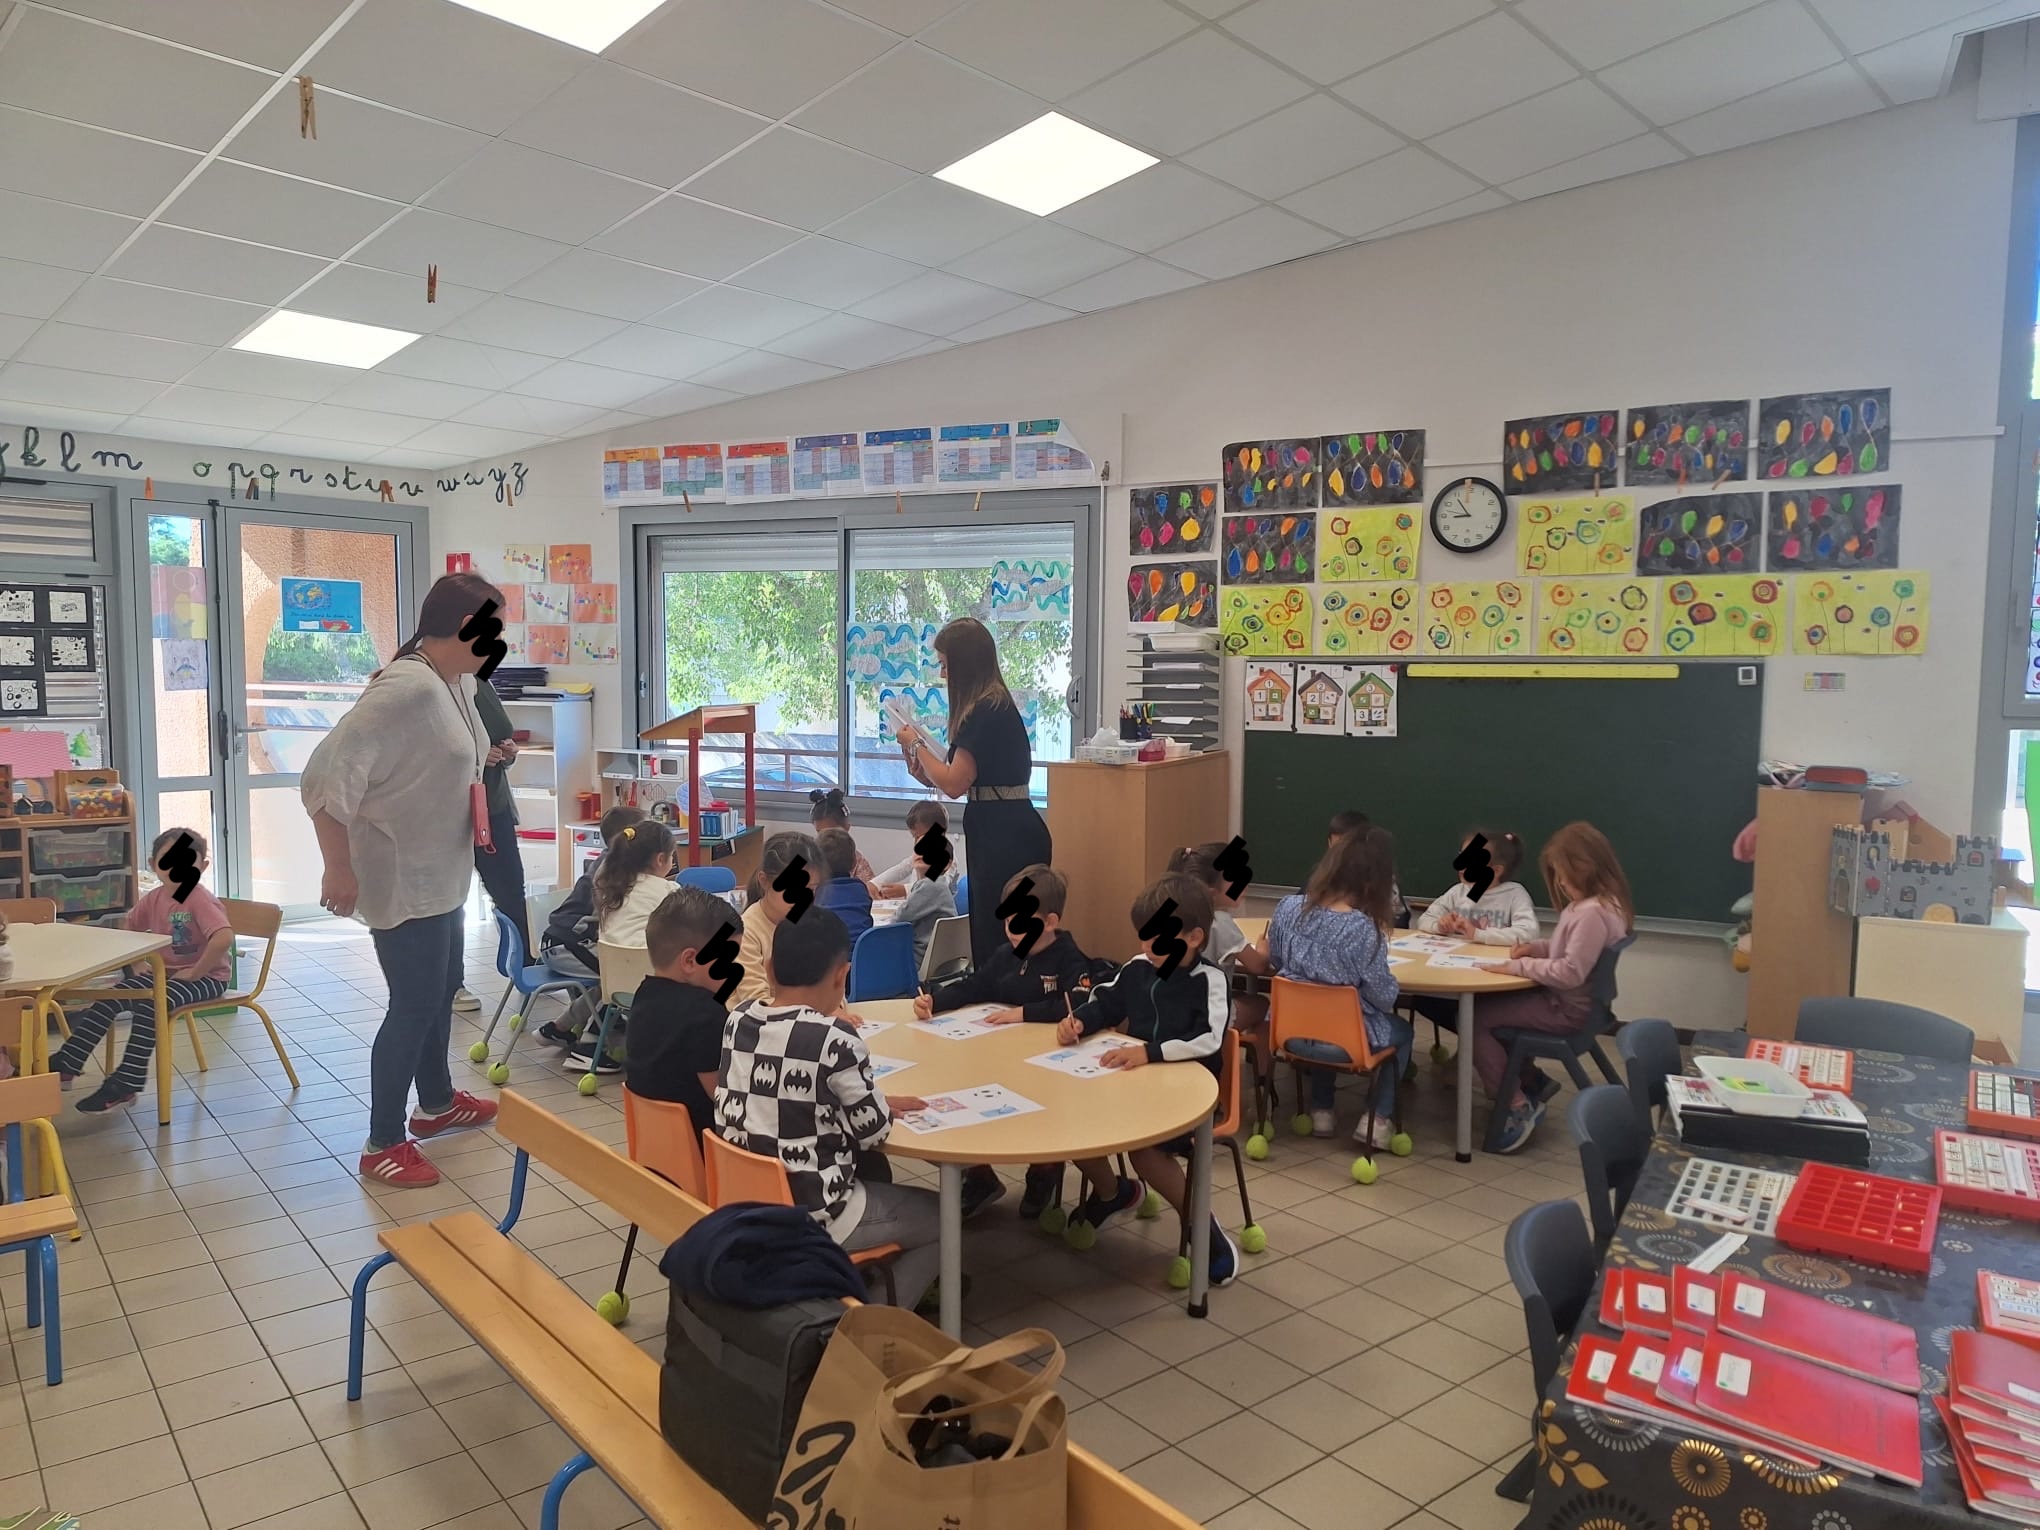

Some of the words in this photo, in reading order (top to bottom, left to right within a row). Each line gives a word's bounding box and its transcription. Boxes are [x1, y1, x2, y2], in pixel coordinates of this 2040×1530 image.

[20, 426, 47, 466] k
[60, 431, 81, 472] l
[91, 450, 143, 471] m
[192, 461, 213, 477] o
[289, 468, 313, 483] r
[324, 472, 338, 487] s
[345, 465, 361, 490] t
[400, 481, 423, 496] v
[436, 476, 460, 492] w
[488, 468, 507, 503] y
[511, 462, 529, 497] z
